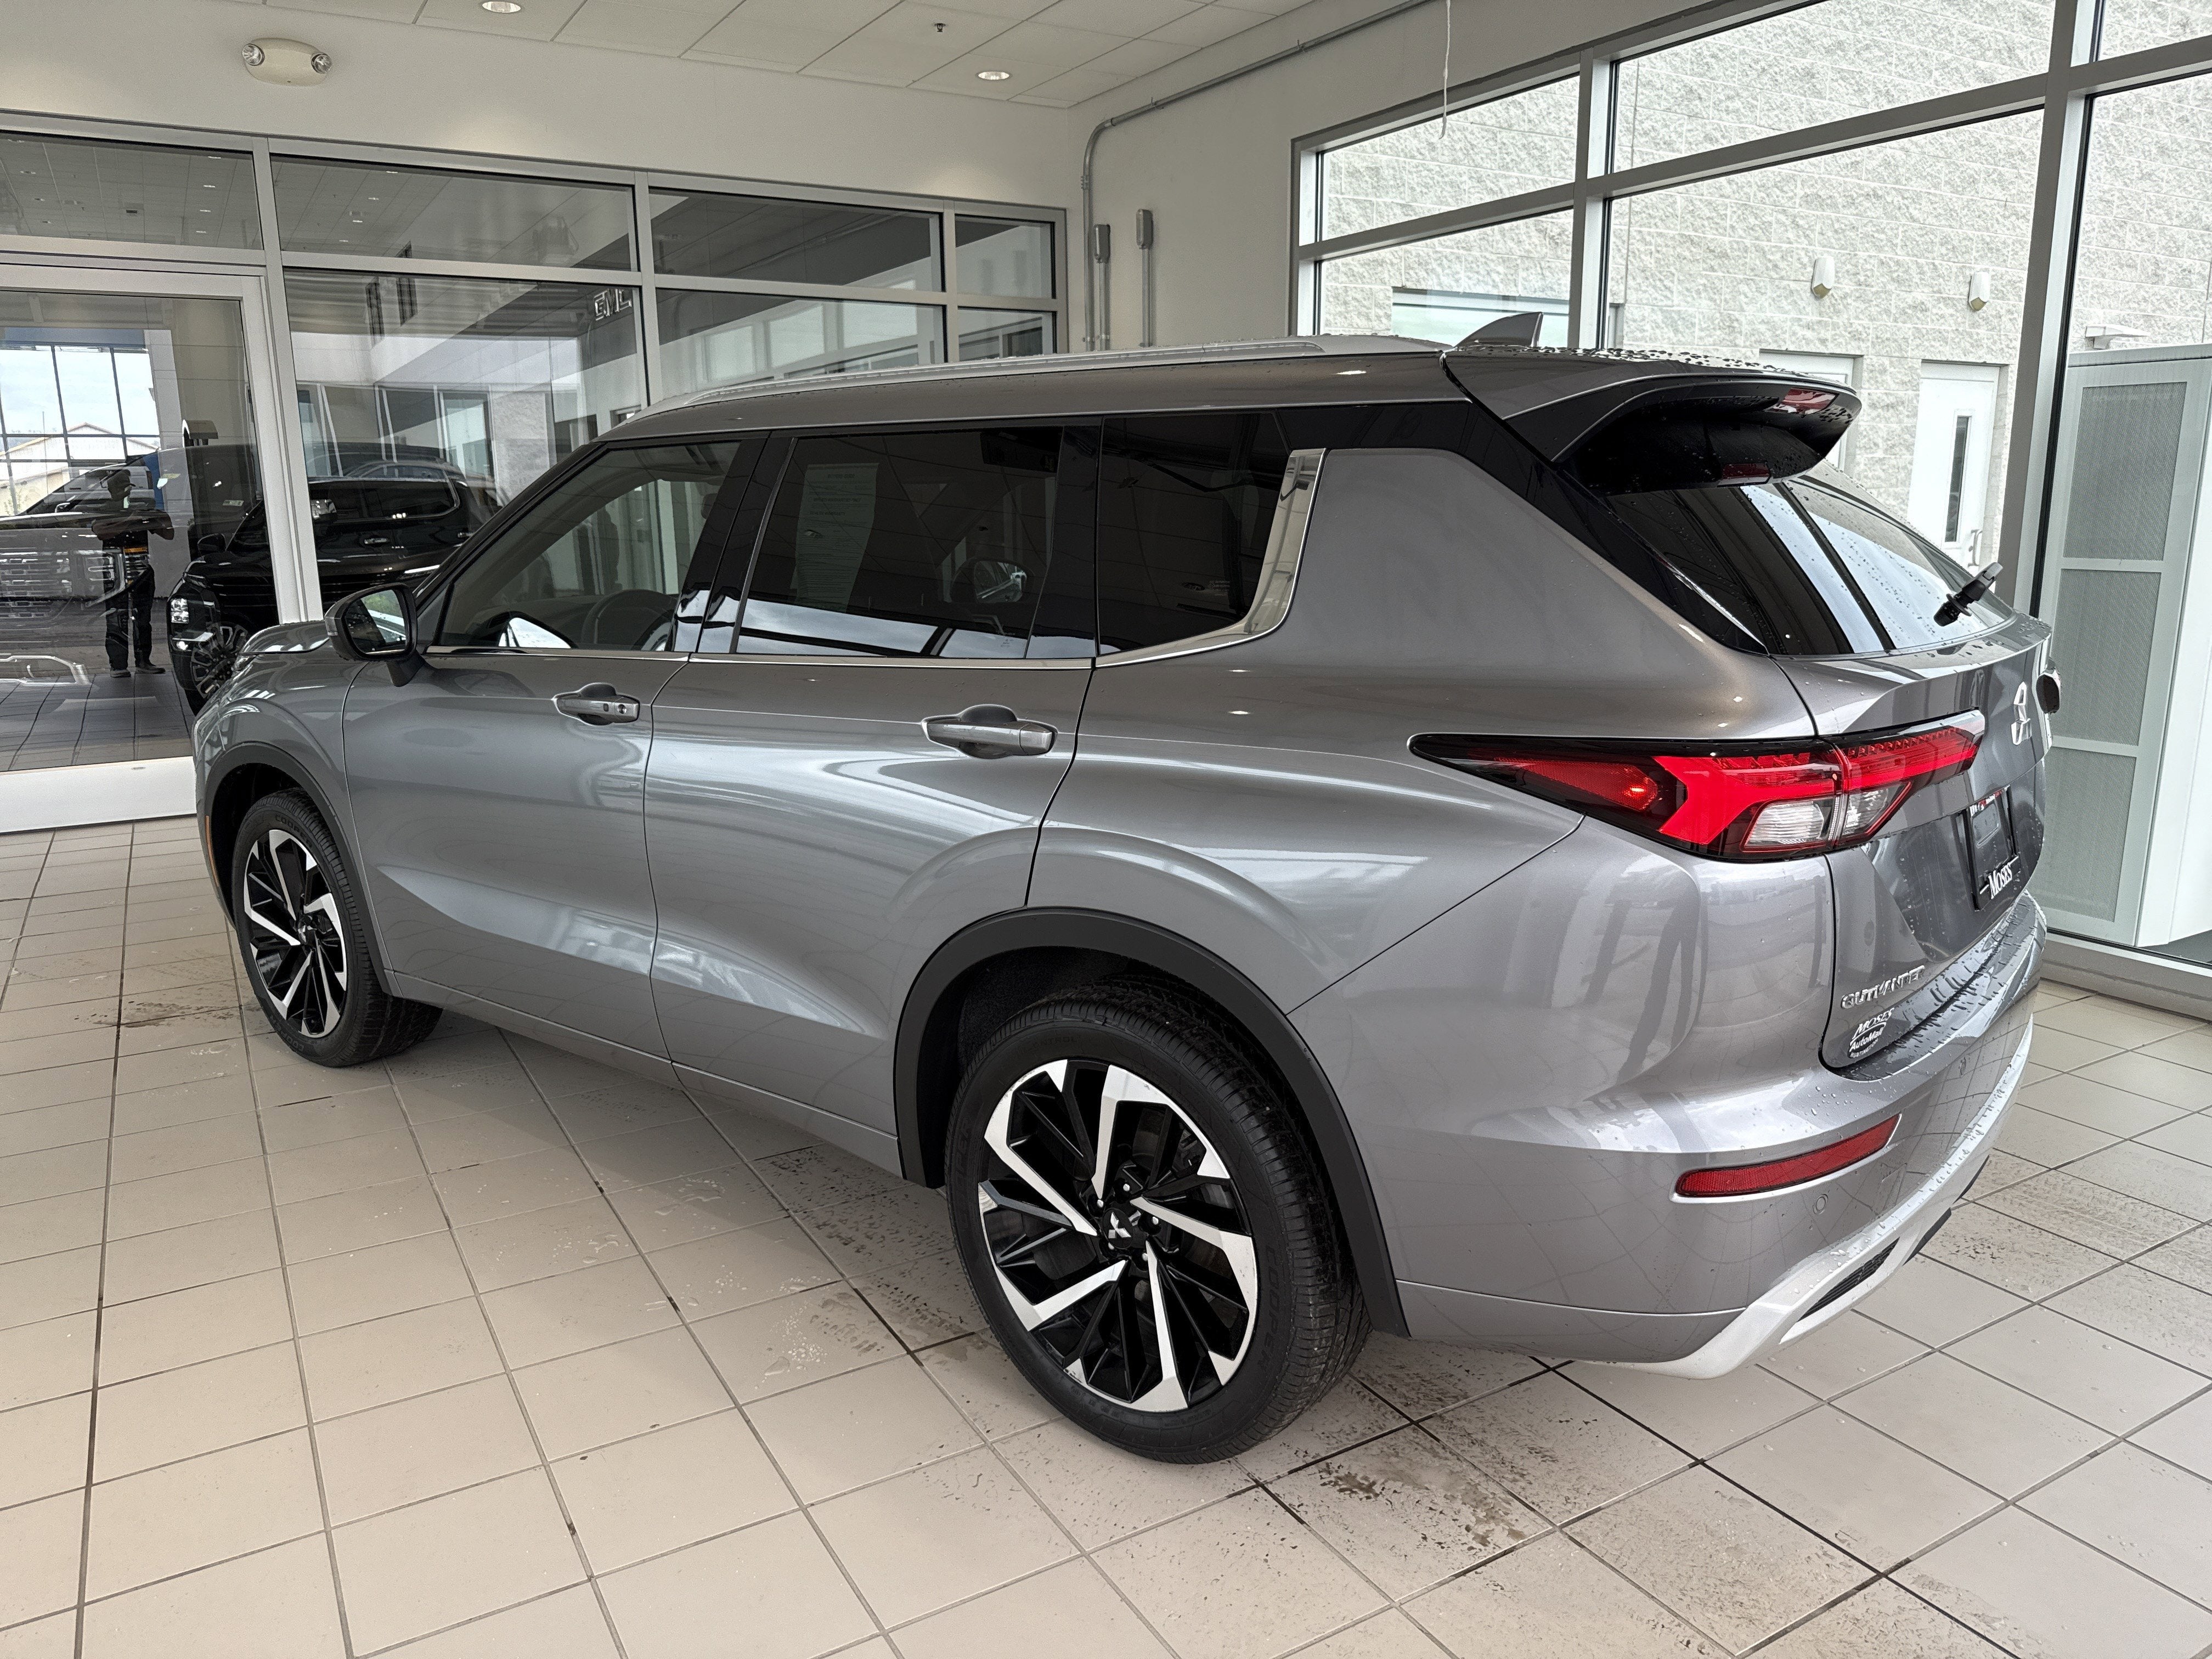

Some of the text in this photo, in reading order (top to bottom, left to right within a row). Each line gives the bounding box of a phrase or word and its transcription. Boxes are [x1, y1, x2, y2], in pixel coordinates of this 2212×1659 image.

[1988, 862, 2013, 900] MOSES
[1849, 1027, 1884, 1052] AutoMall
[1852, 1007, 1895, 1040] MOSES
